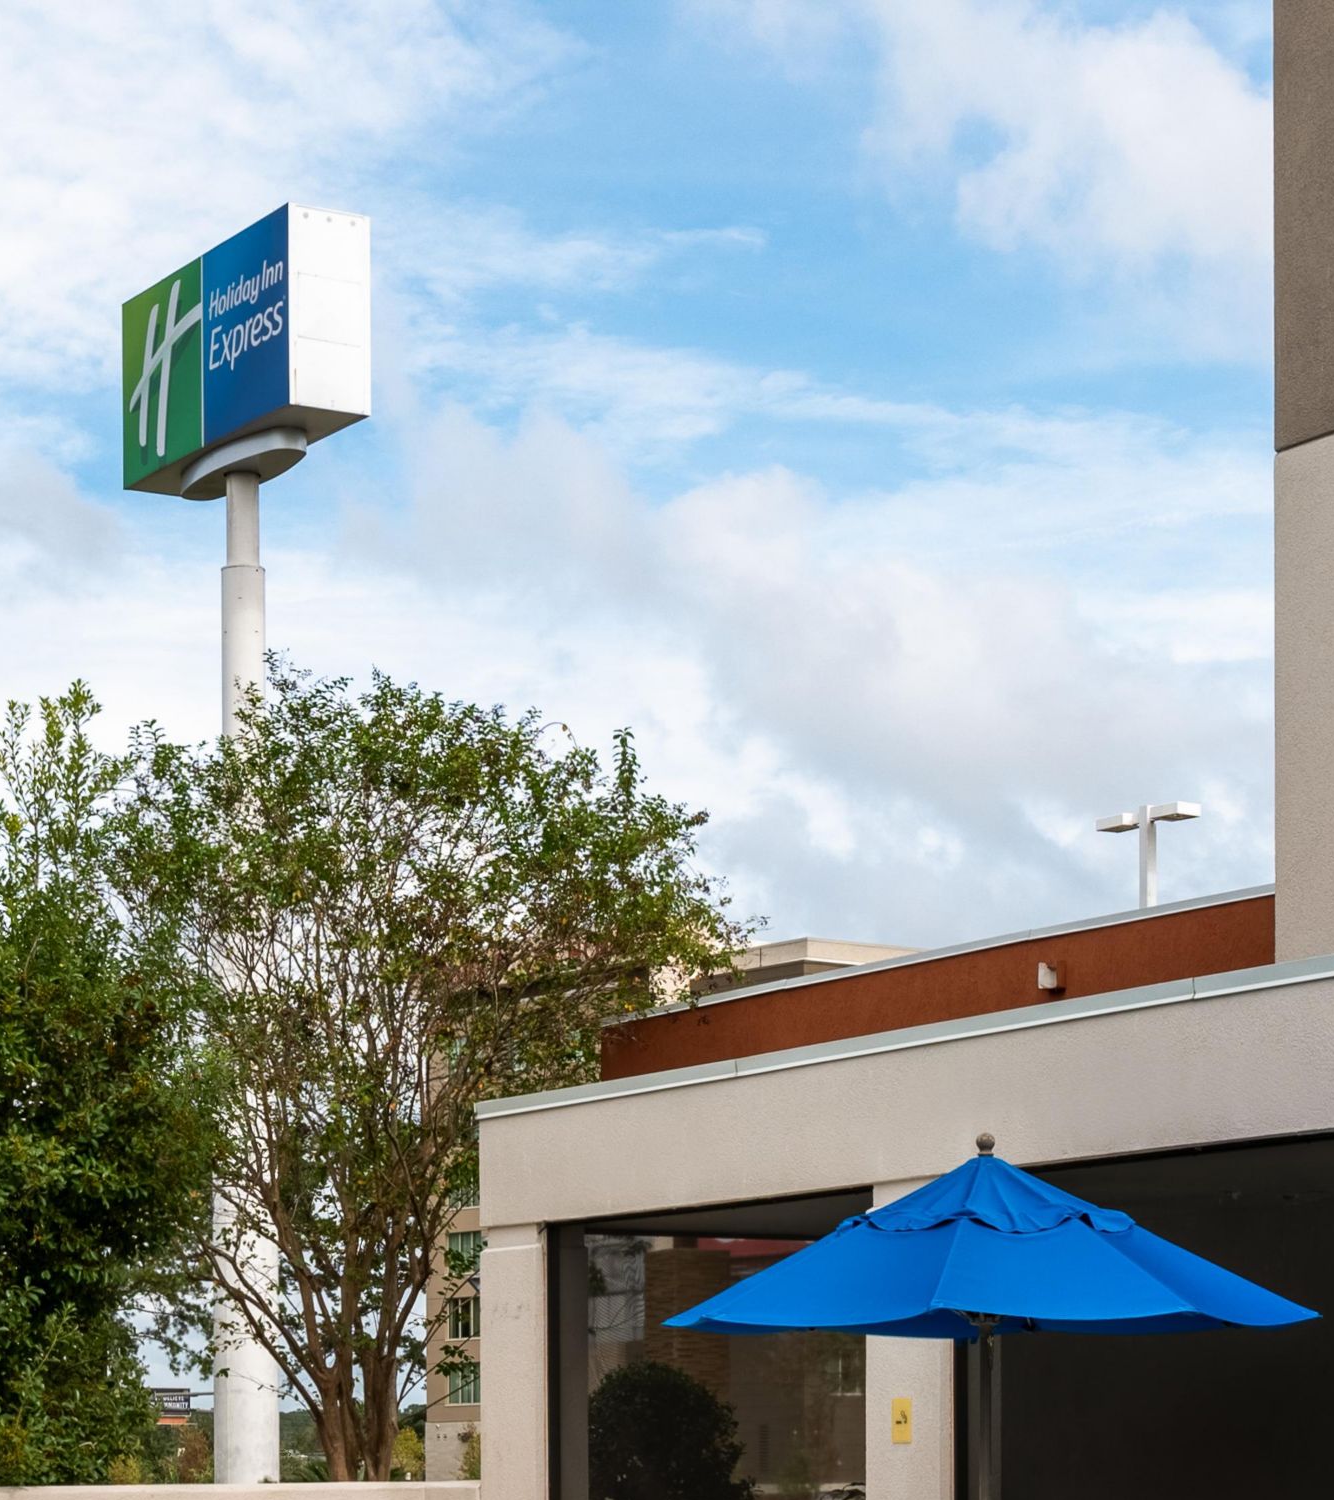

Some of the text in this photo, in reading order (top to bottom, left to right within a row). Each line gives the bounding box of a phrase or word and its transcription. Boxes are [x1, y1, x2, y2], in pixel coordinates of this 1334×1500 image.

[208, 259, 283, 321] Holiday Inn
[208, 300, 284, 371] Express
